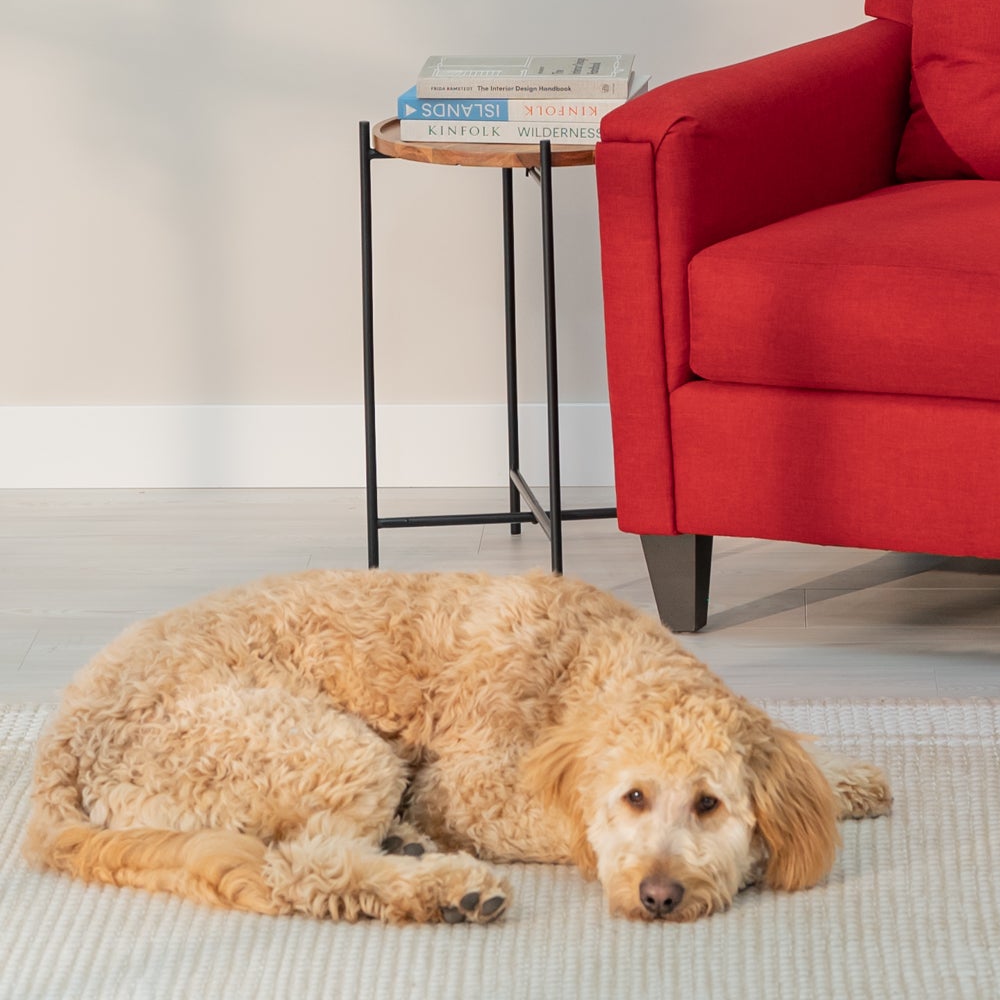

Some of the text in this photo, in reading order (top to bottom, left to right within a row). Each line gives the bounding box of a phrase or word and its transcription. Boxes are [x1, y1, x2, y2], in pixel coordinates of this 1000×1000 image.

[421, 103, 500, 118] ISLANDS
[524, 105, 597, 116] KINFOLK
[428, 125, 501, 137] KINFOLK
